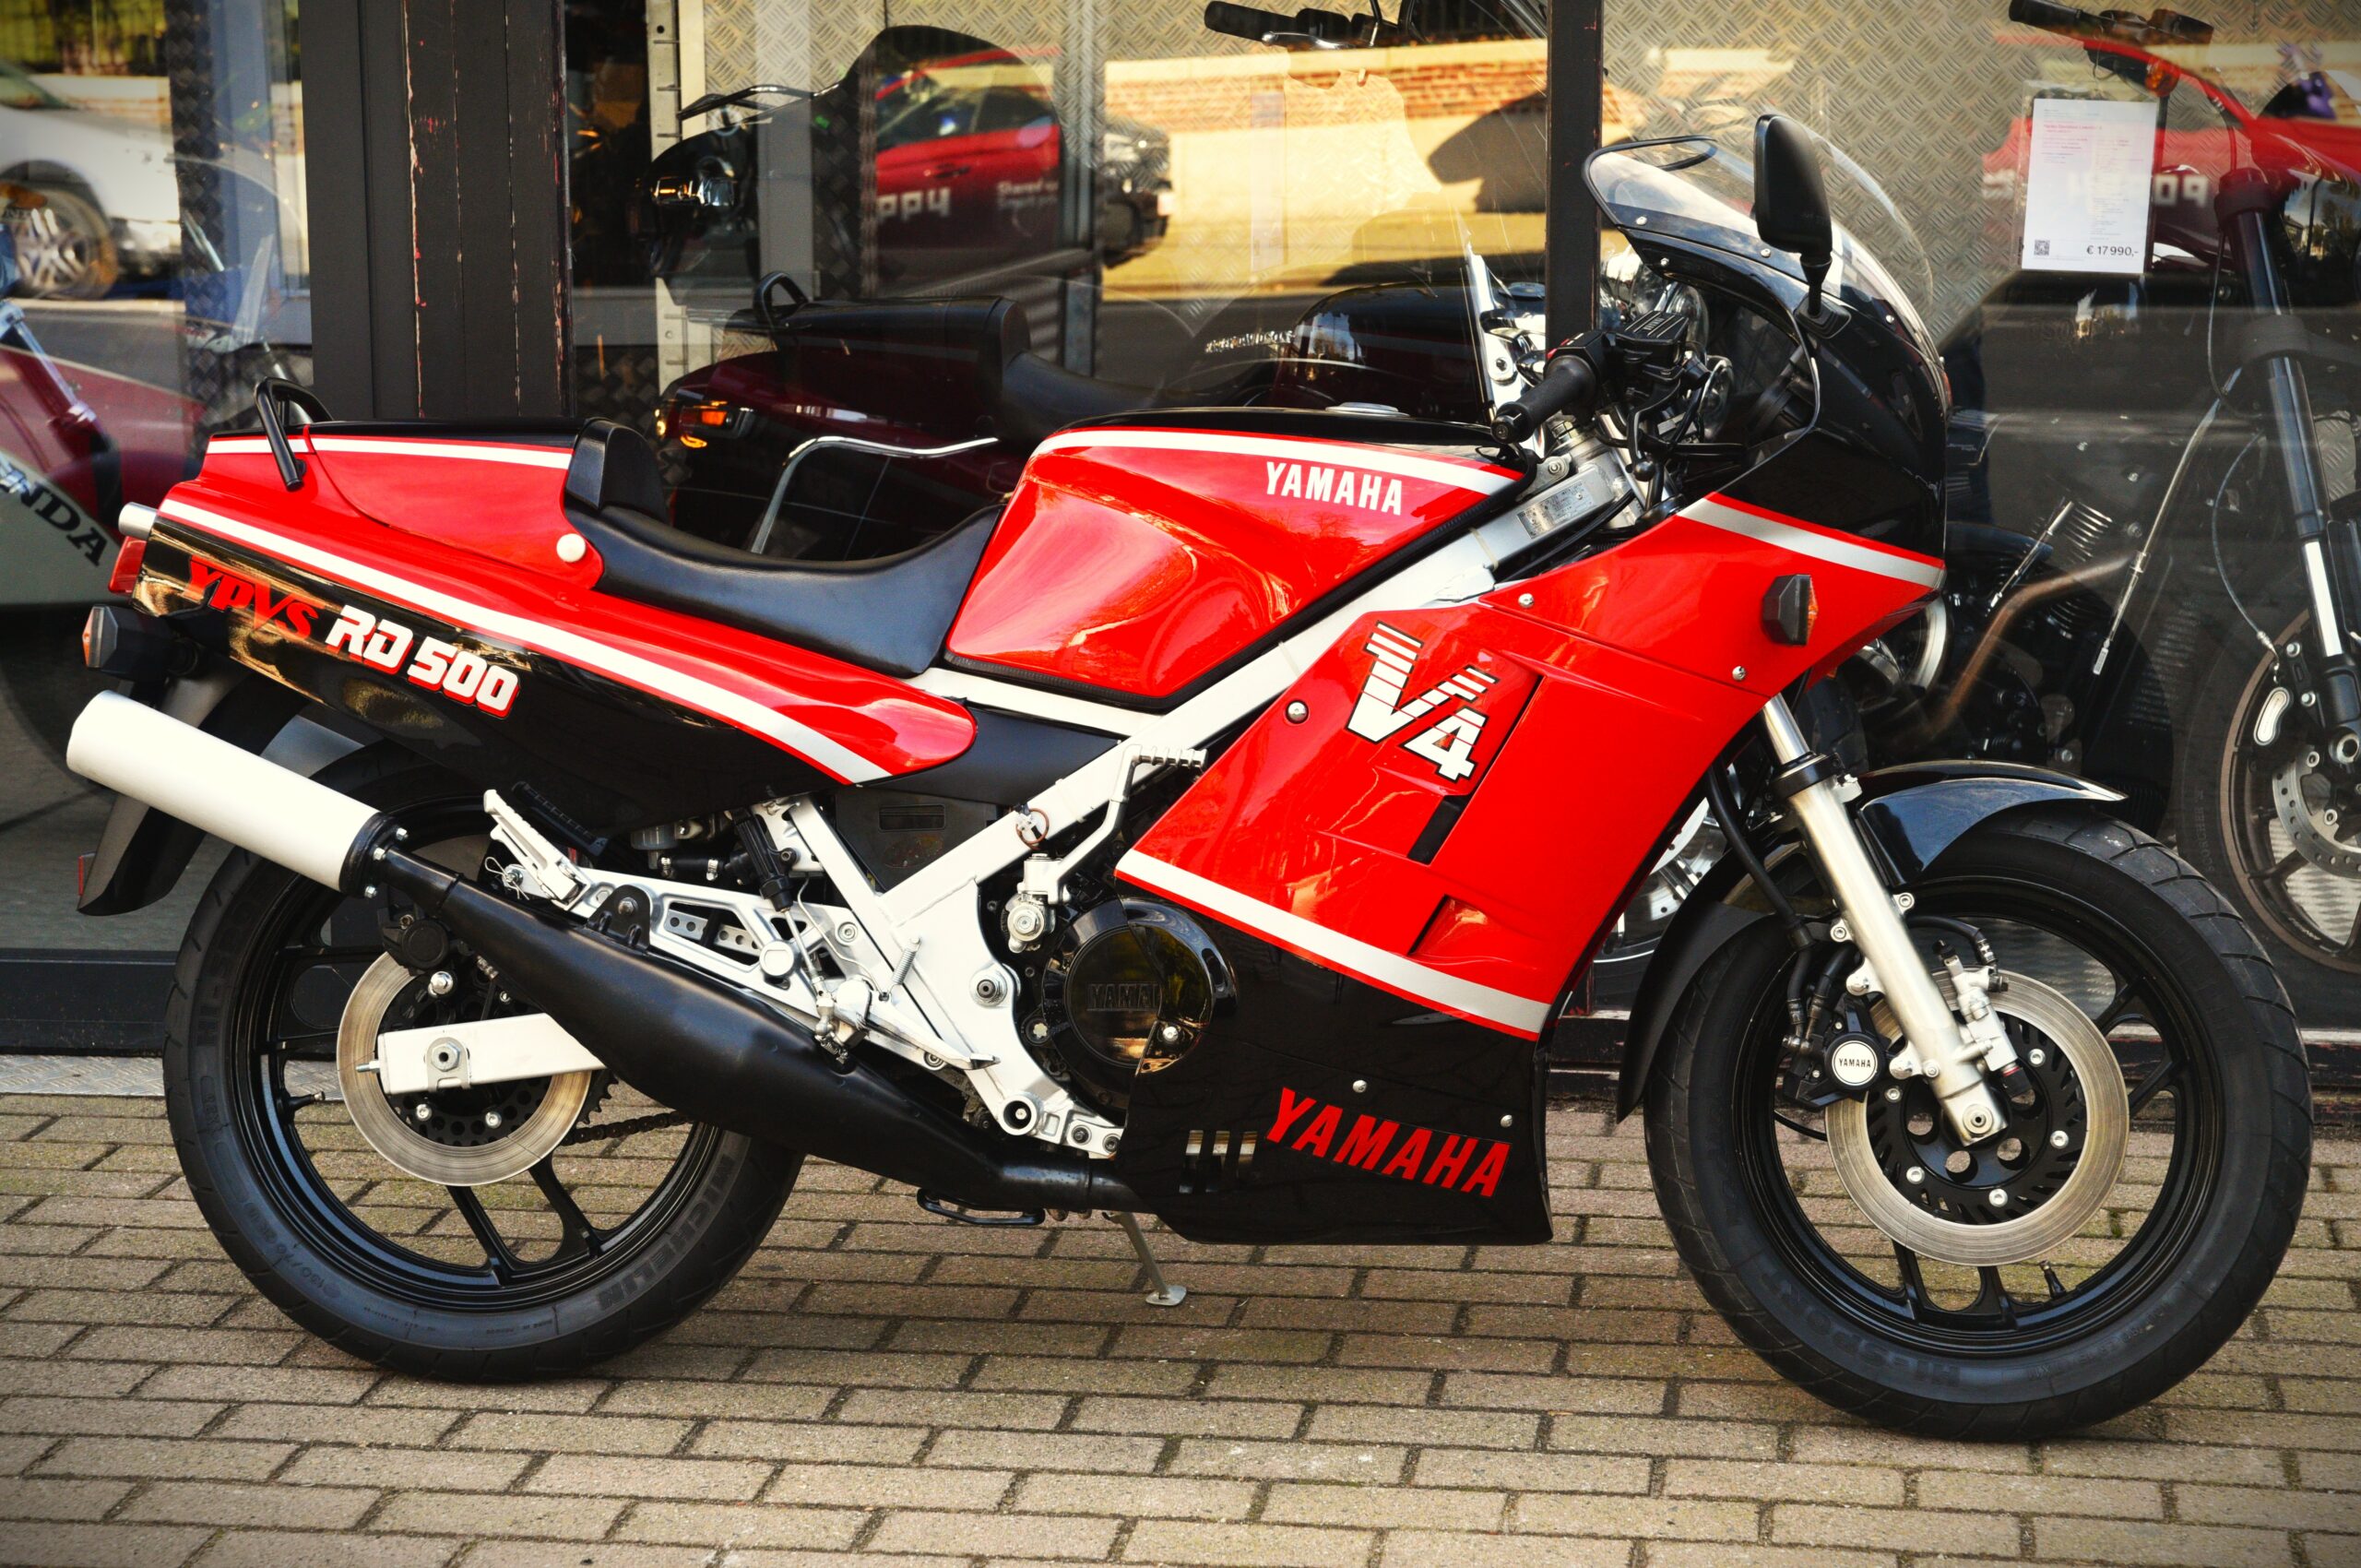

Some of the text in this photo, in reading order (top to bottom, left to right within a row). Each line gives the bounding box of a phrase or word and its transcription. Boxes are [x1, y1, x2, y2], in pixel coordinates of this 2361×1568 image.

[876, 187, 951, 225] ppy
[1266, 461, 1403, 517] YAMAHA
[187, 556, 320, 640] YPVS
[326, 604, 522, 718] RD 500
[1347, 621, 1496, 782] V4
[1088, 983, 1161, 1010] YAMA
[1839, 1058, 1871, 1068] YAMAHA
[1267, 1087, 1510, 1196] YAMAHA
[593, 1153, 739, 1312] MICHELIN
